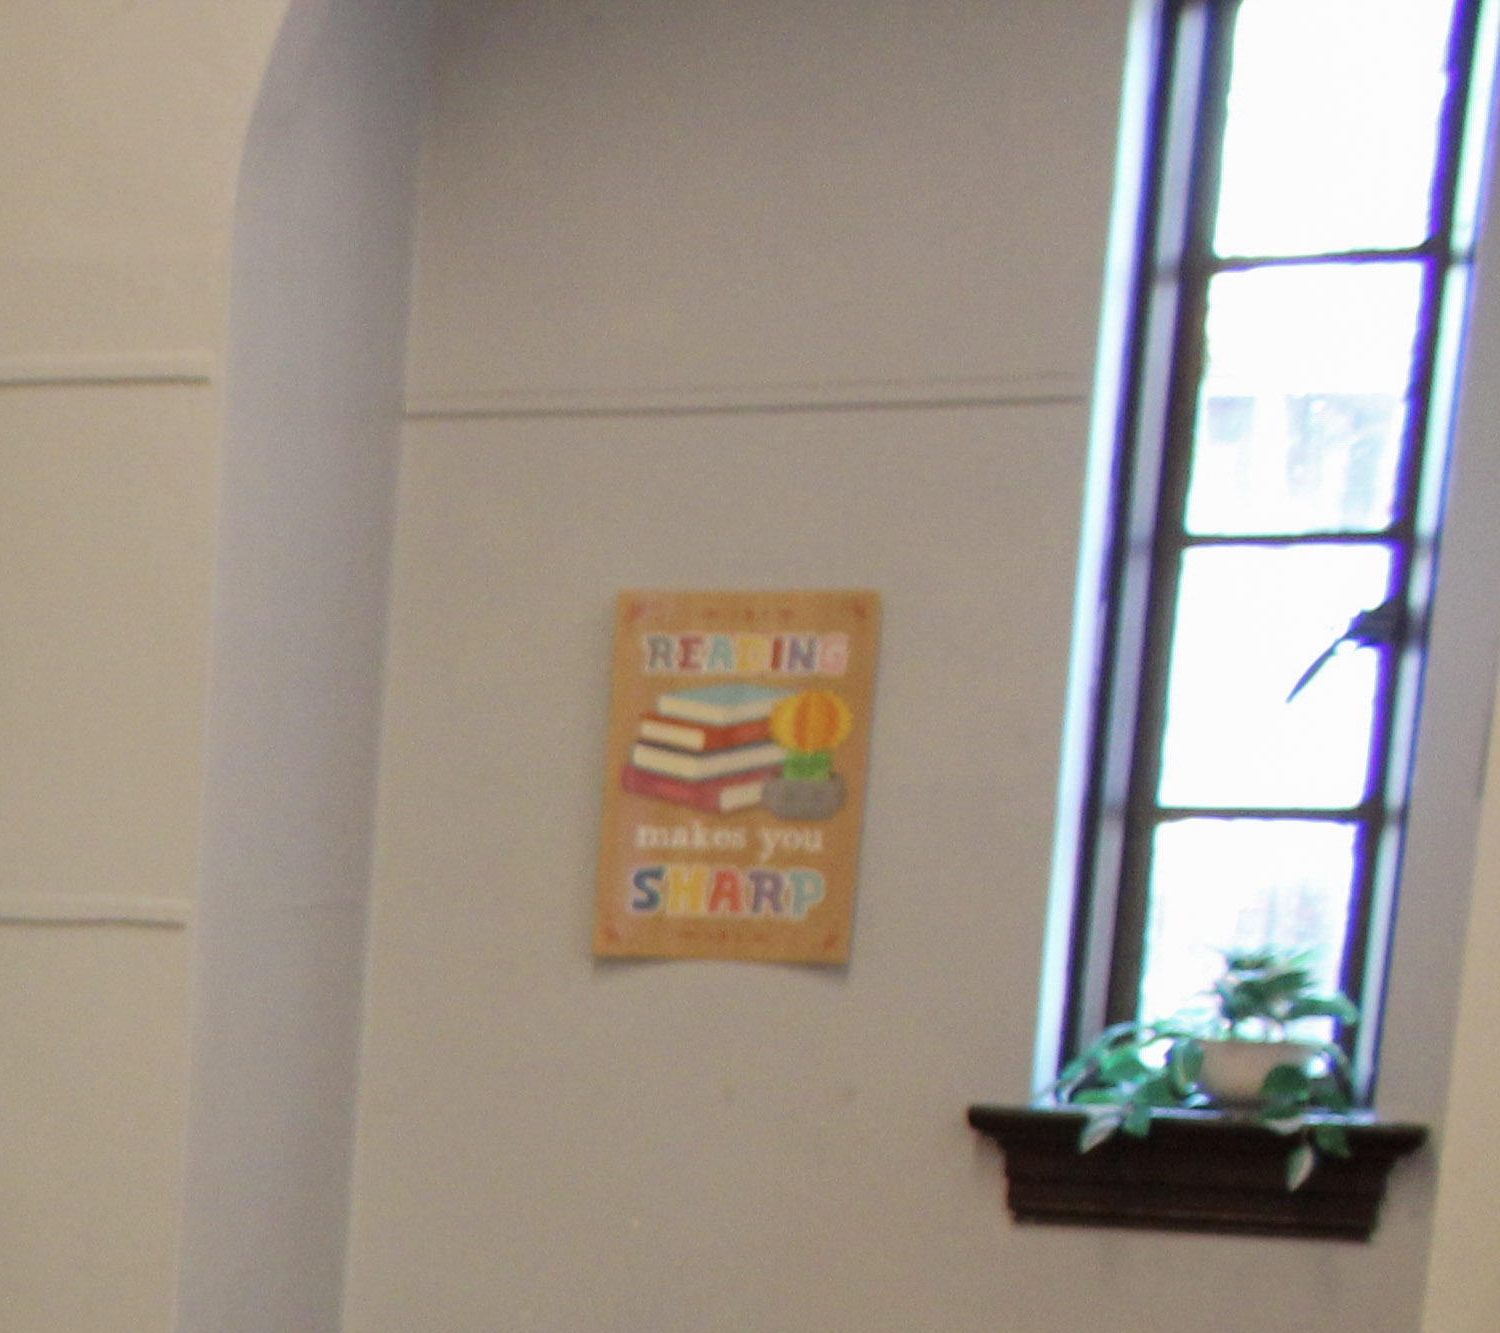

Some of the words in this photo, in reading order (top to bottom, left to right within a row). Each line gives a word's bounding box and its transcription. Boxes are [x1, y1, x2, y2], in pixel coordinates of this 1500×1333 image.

[645, 631, 850, 677] READING
[635, 819, 747, 850] makes
[758, 827, 824, 863] you
[628, 865, 826, 920] SHARP
